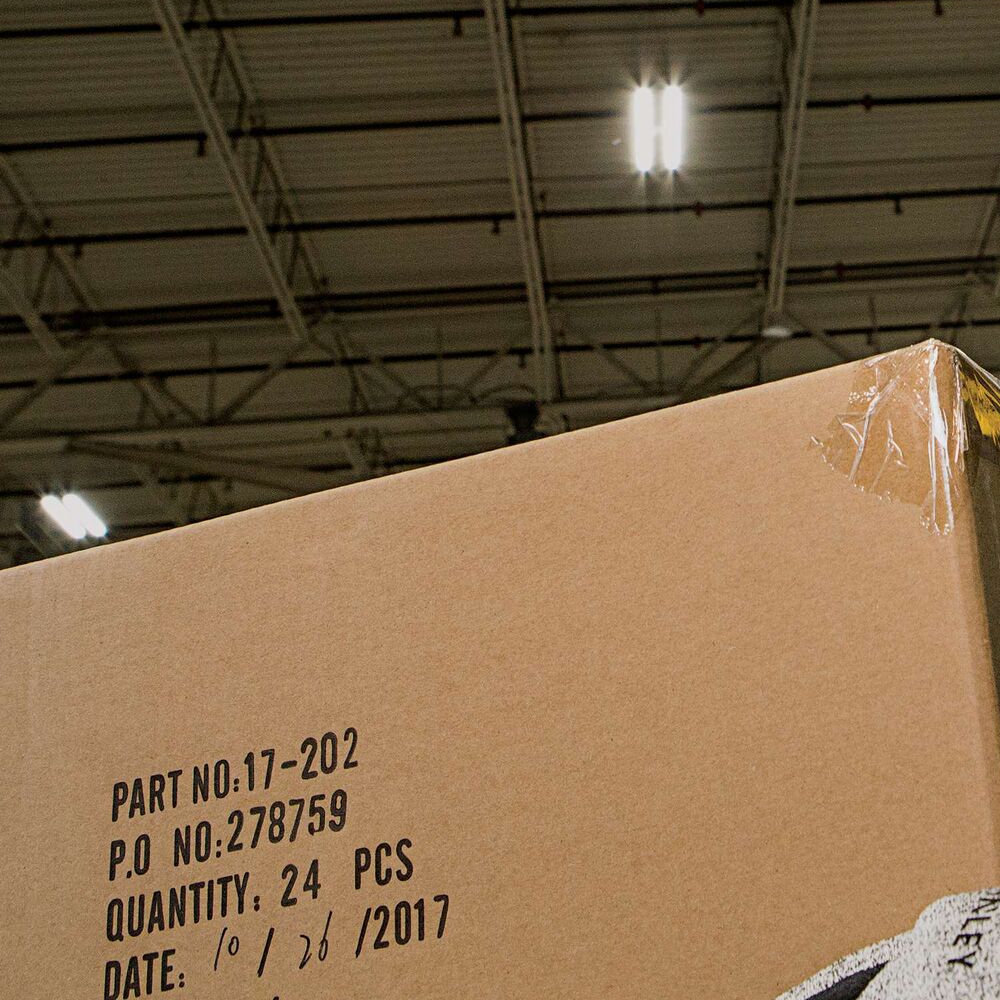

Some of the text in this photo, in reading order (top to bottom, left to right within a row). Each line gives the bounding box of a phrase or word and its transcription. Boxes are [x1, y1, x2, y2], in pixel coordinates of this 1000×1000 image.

[112, 727, 359, 822] PART NO:17-202
[109, 789, 348, 881] P.O NO:278759
[106, 838, 414, 942] QUANTITY: 24 PCS
[103, 949, 185, 1000] DATE:
